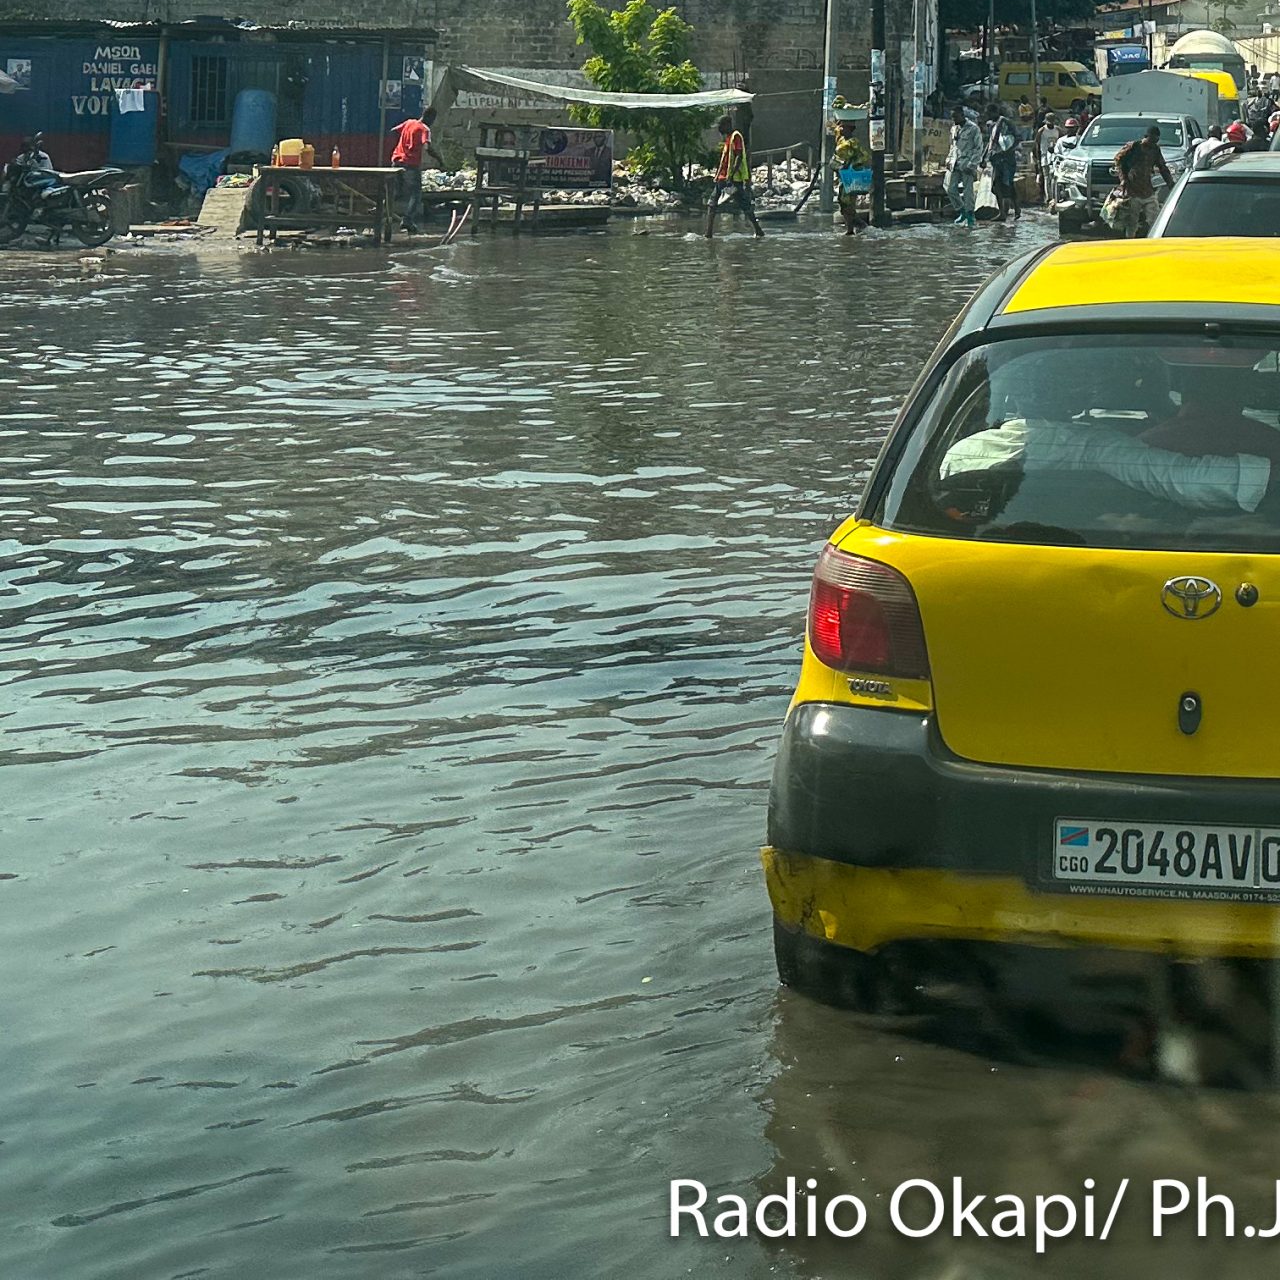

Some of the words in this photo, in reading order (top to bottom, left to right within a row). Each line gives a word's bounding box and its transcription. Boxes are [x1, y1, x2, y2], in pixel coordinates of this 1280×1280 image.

[83, 63, 124, 74] DANIEL
[130, 64, 158, 75] GAEL
[846, 677, 893, 695] TOYOTA
[1059, 856, 1088, 873] CGO
